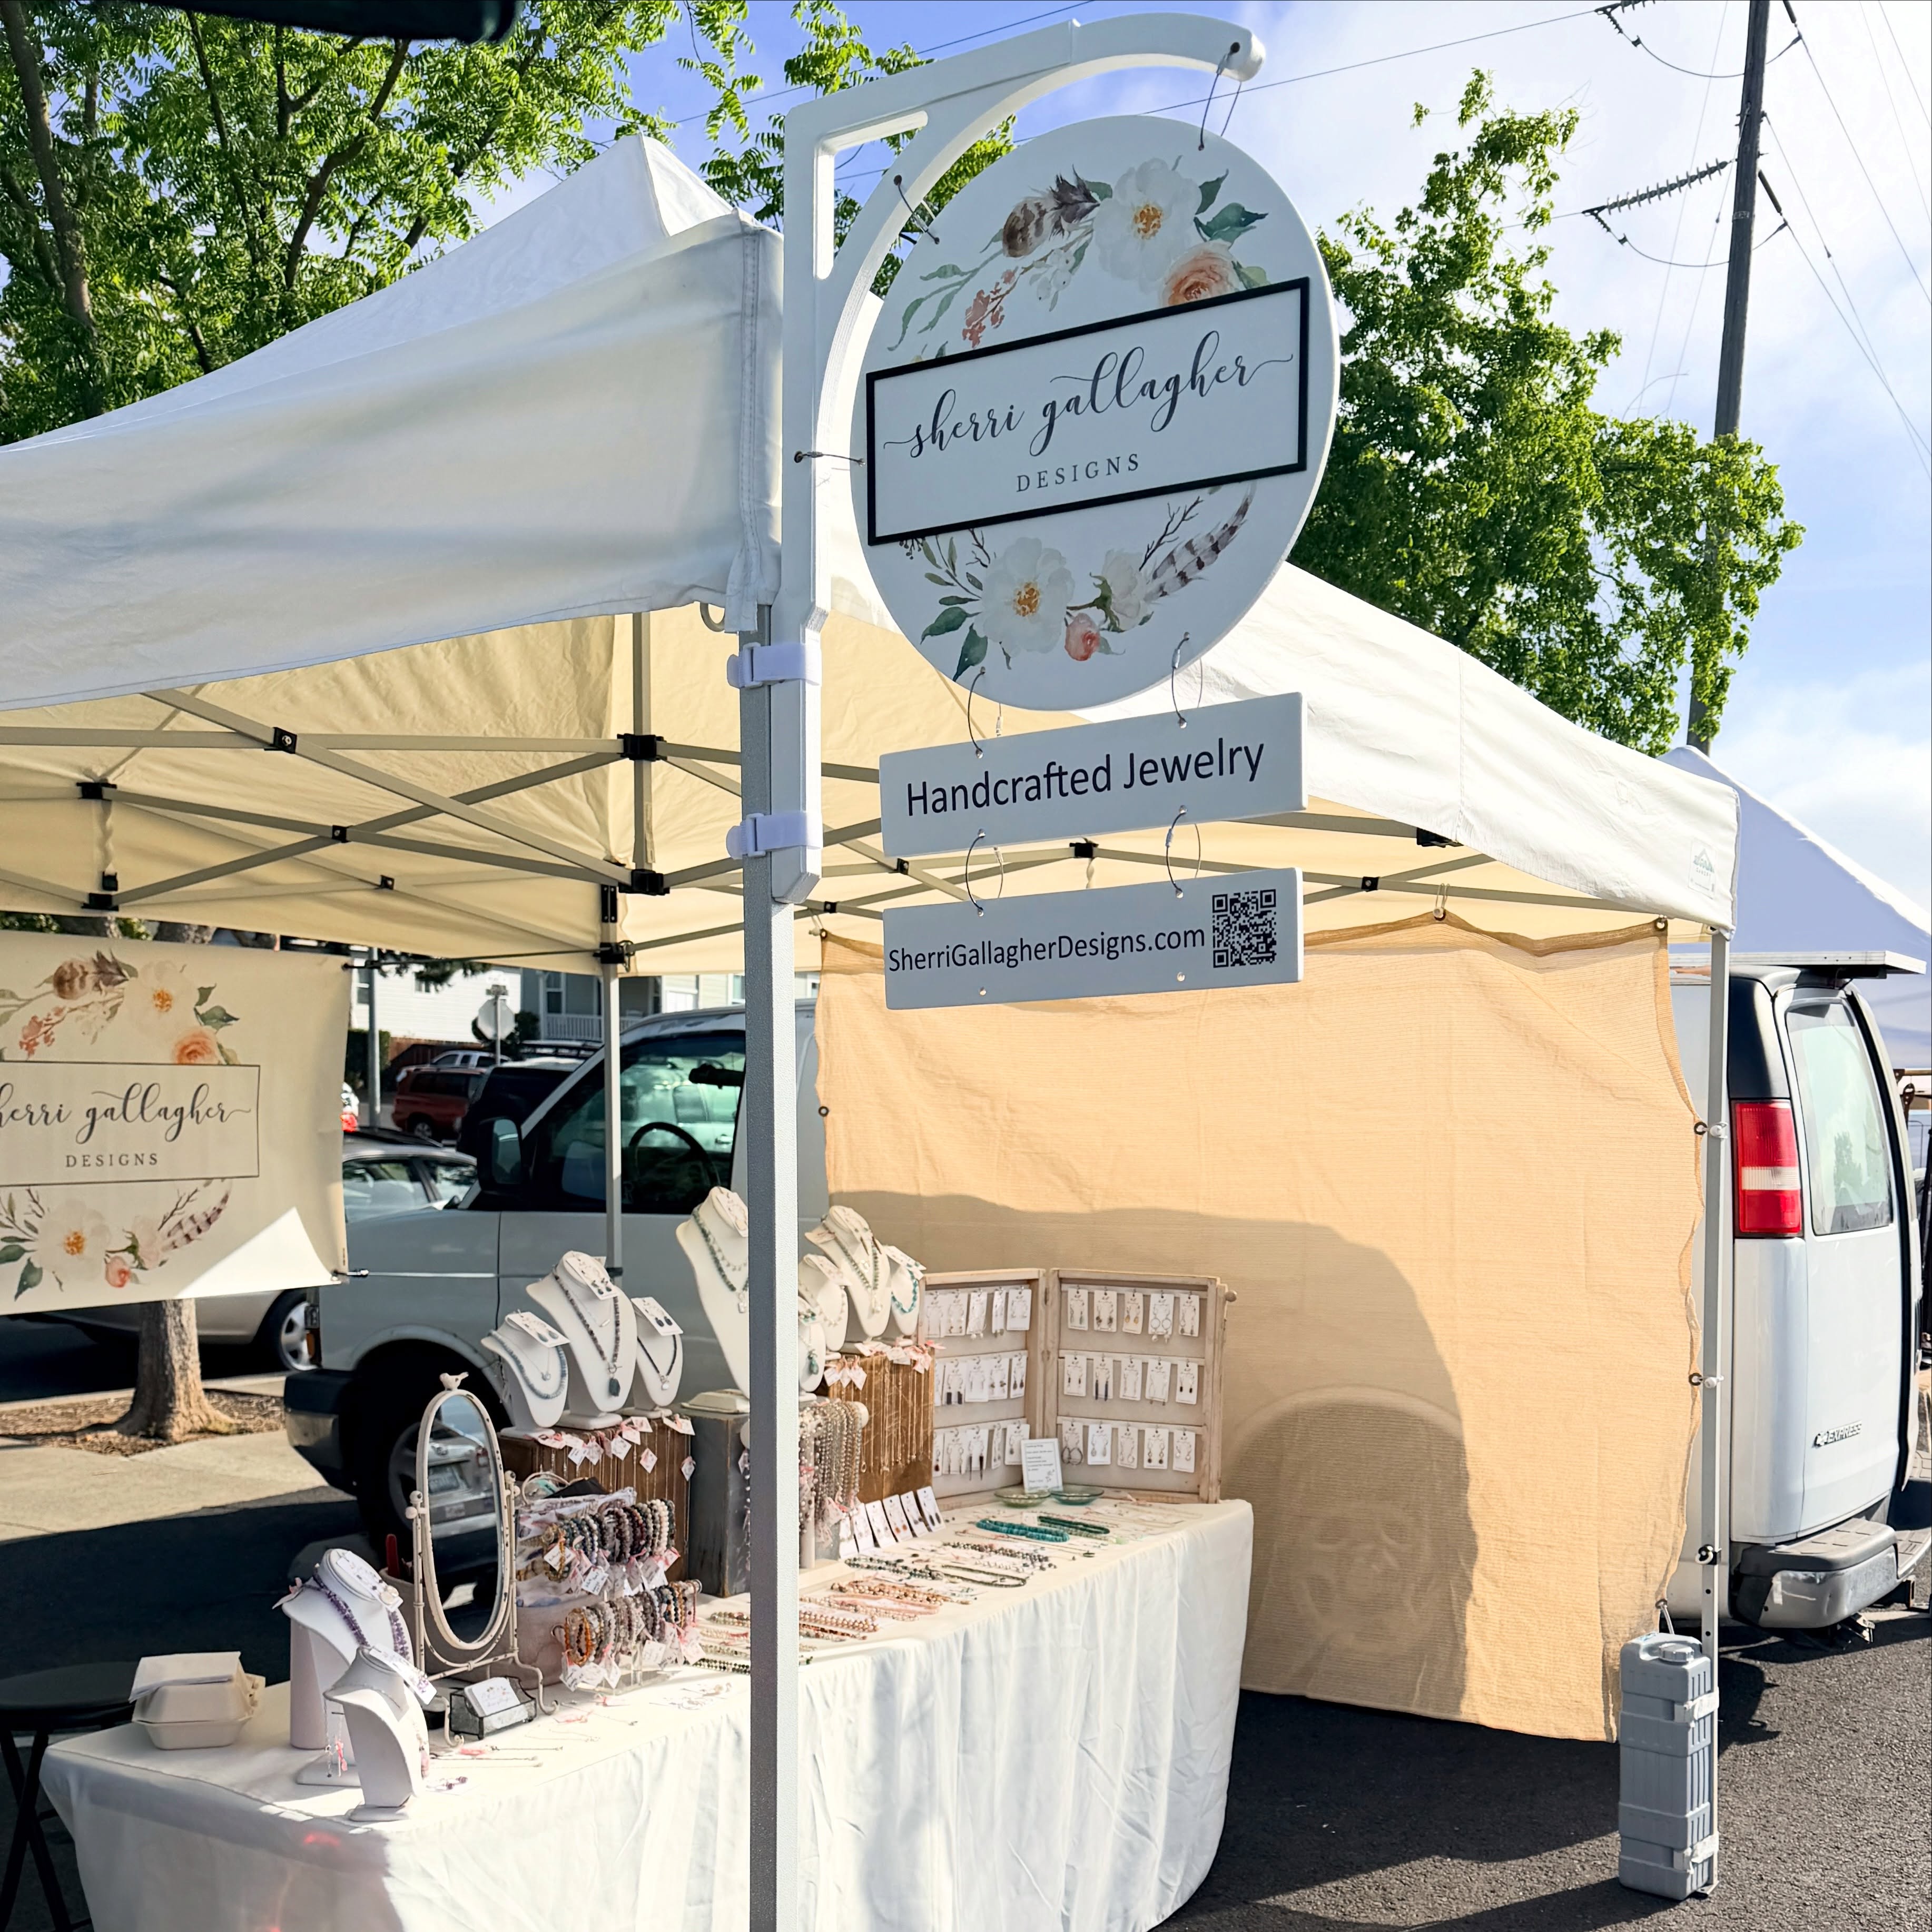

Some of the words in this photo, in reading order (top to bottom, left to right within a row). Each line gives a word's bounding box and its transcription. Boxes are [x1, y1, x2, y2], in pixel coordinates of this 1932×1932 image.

[883, 389, 1025, 458] sherri
[1029, 330, 1294, 457] gallagher
[1016, 453, 1140, 492] DESIGNS
[907, 754, 1111, 816] Handcrafted
[1123, 737, 1265, 789] Jewelry
[889, 929, 1205, 972] SherriGallagherDesigns.com
[0, 1082, 72, 1128] herri
[75, 1082, 251, 1145] gallagher
[66, 1153, 158, 1168] DESIGNS
